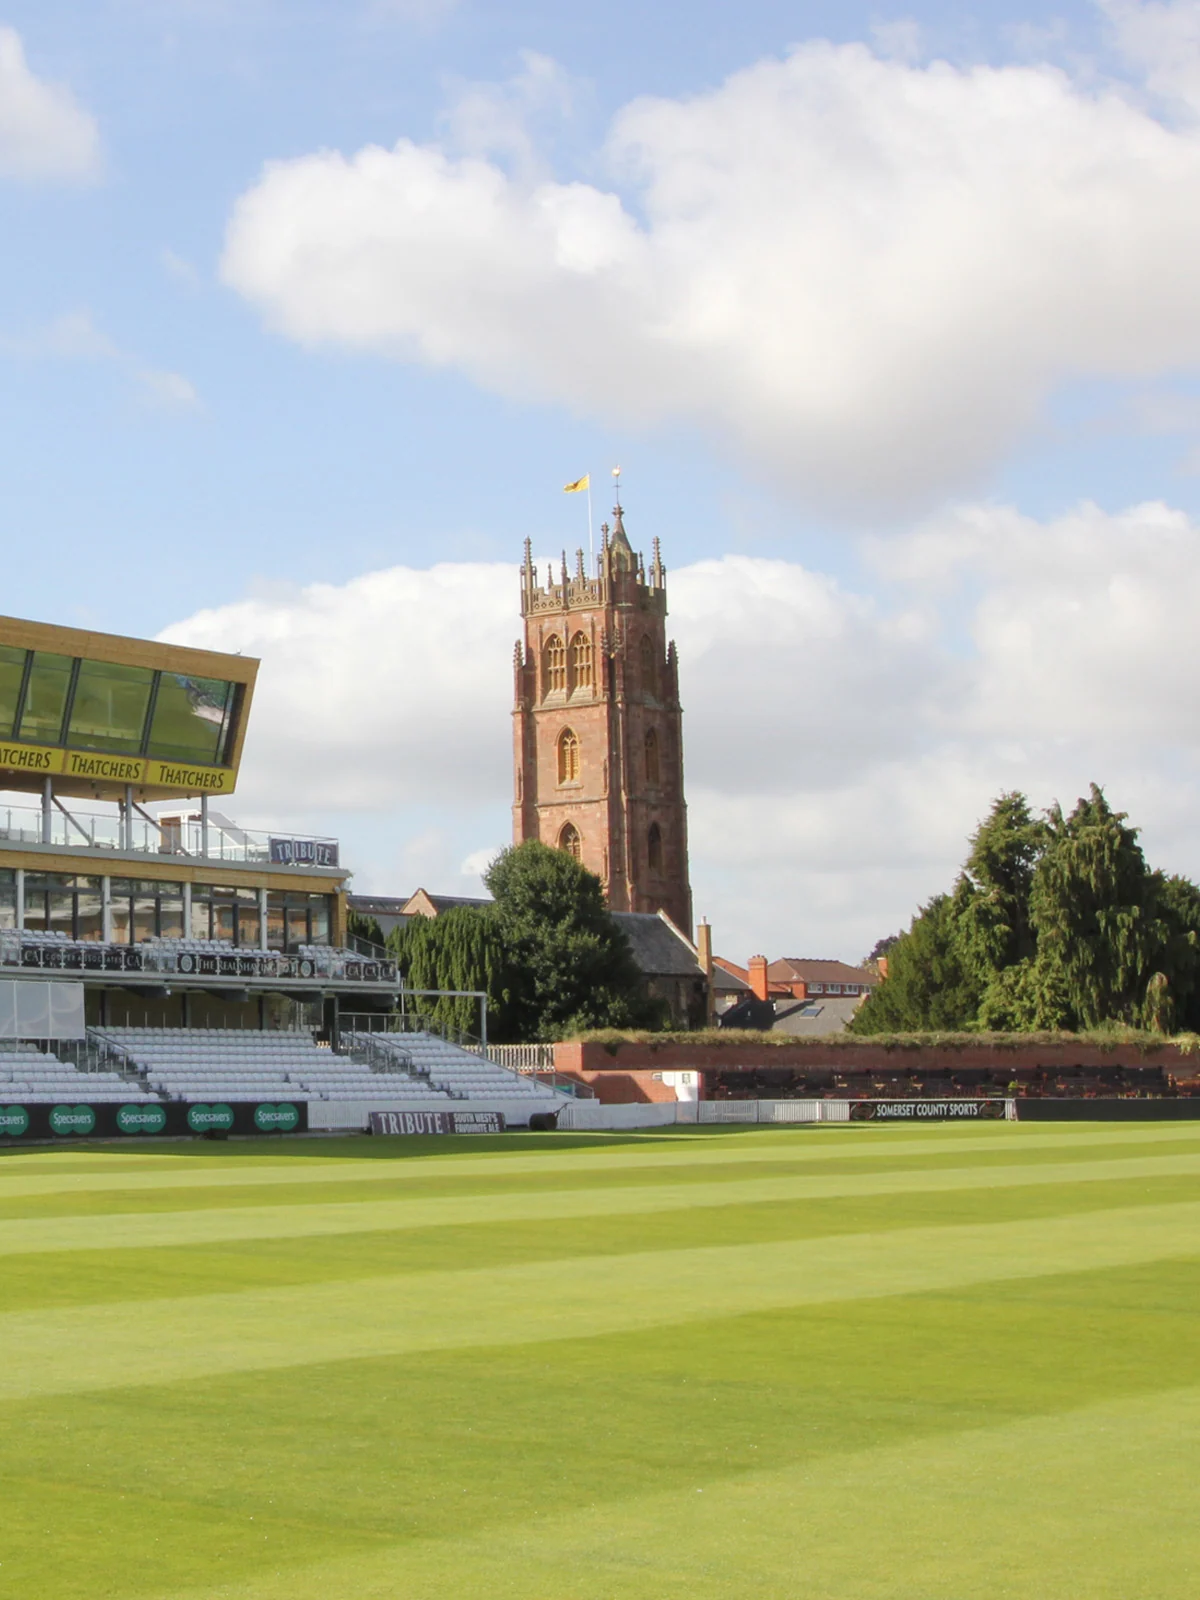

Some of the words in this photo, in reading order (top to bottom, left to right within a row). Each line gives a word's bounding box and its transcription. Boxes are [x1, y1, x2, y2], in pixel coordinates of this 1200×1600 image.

[72, 754, 141, 779] THATCHERS
[159, 765, 225, 789] THATCHERS
[276, 842, 331, 865] TRIBUTE
[191, 1111, 230, 1124] Specsavers
[258, 1110, 295, 1123] Specsavers
[876, 1103, 915, 1117] SOMERSET
[916, 1104, 948, 1116] COUNTY
[949, 1103, 978, 1116] SPORTS
[53, 1112, 92, 1127] Specsavers
[120, 1112, 162, 1126] Specsavers
[378, 1112, 443, 1135] TRIBUTE
